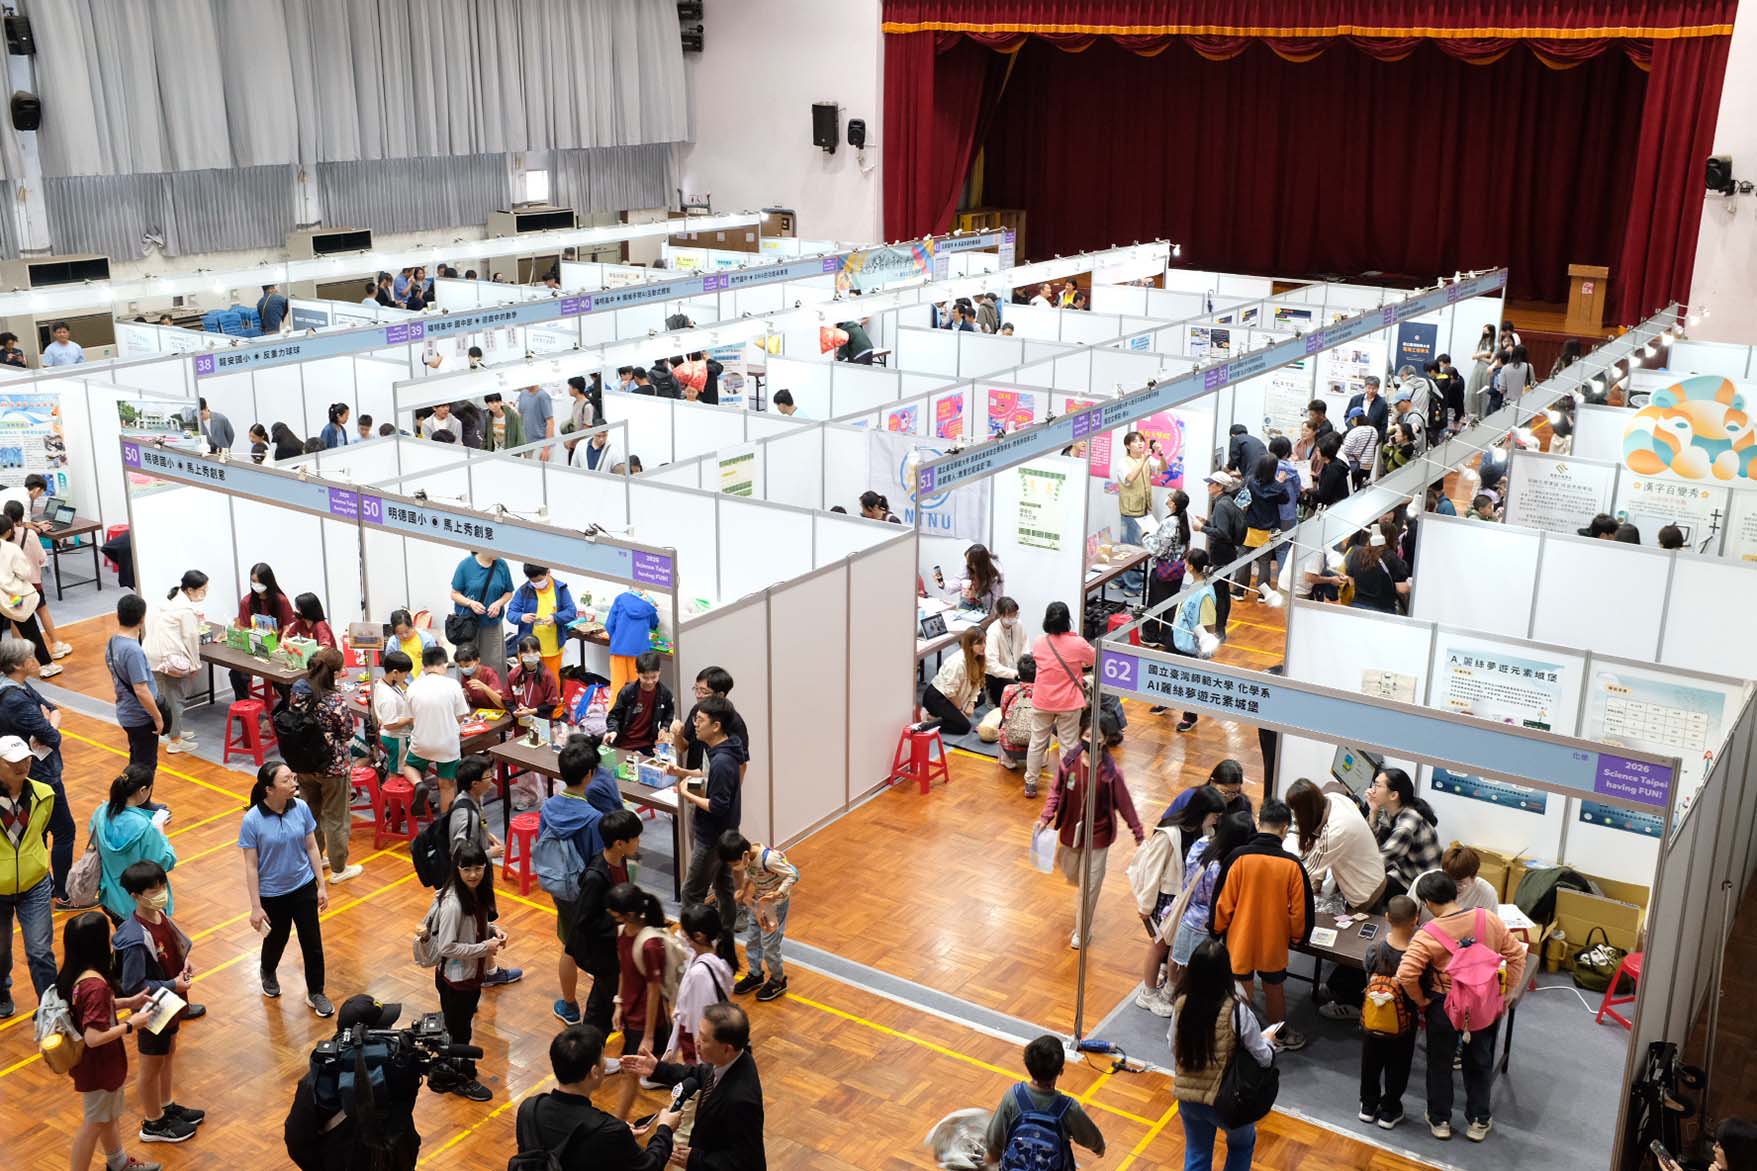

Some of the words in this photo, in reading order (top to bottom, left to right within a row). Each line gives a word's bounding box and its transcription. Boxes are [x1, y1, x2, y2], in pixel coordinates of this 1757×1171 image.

[581, 299, 590, 309] 40
[410, 326, 422, 336] 39
[197, 359, 212, 371] 38
[219, 353, 251, 367] 龍安國小
[263, 346, 300, 360] 反重力球球
[125, 447, 138, 462] 50
[144, 452, 175, 469] 明德國小
[187, 462, 226, 481] 馬上秀創意
[920, 472, 932, 489] 51
[1643, 481, 1699, 499] 漢字百變秀
[363, 500, 379, 517] 50
[388, 506, 427, 526] 明德國小
[443, 518, 494, 541] 馬上秀創意
[635, 561, 655, 571] Science
[1104, 658, 1132, 682] 62
[1148, 664, 1234, 691] 國立臺灣師範大學
[1238, 682, 1271, 699] 化學系
[1147, 680, 1260, 713] AI麗絲夢遊元素城堡
[1625, 761, 1650, 774] 2026
[1603, 768, 1639, 783] Science
[1640, 775, 1669, 789] Taipei
[1606, 780, 1637, 795] having
[1638, 786, 1663, 799] FUN!
